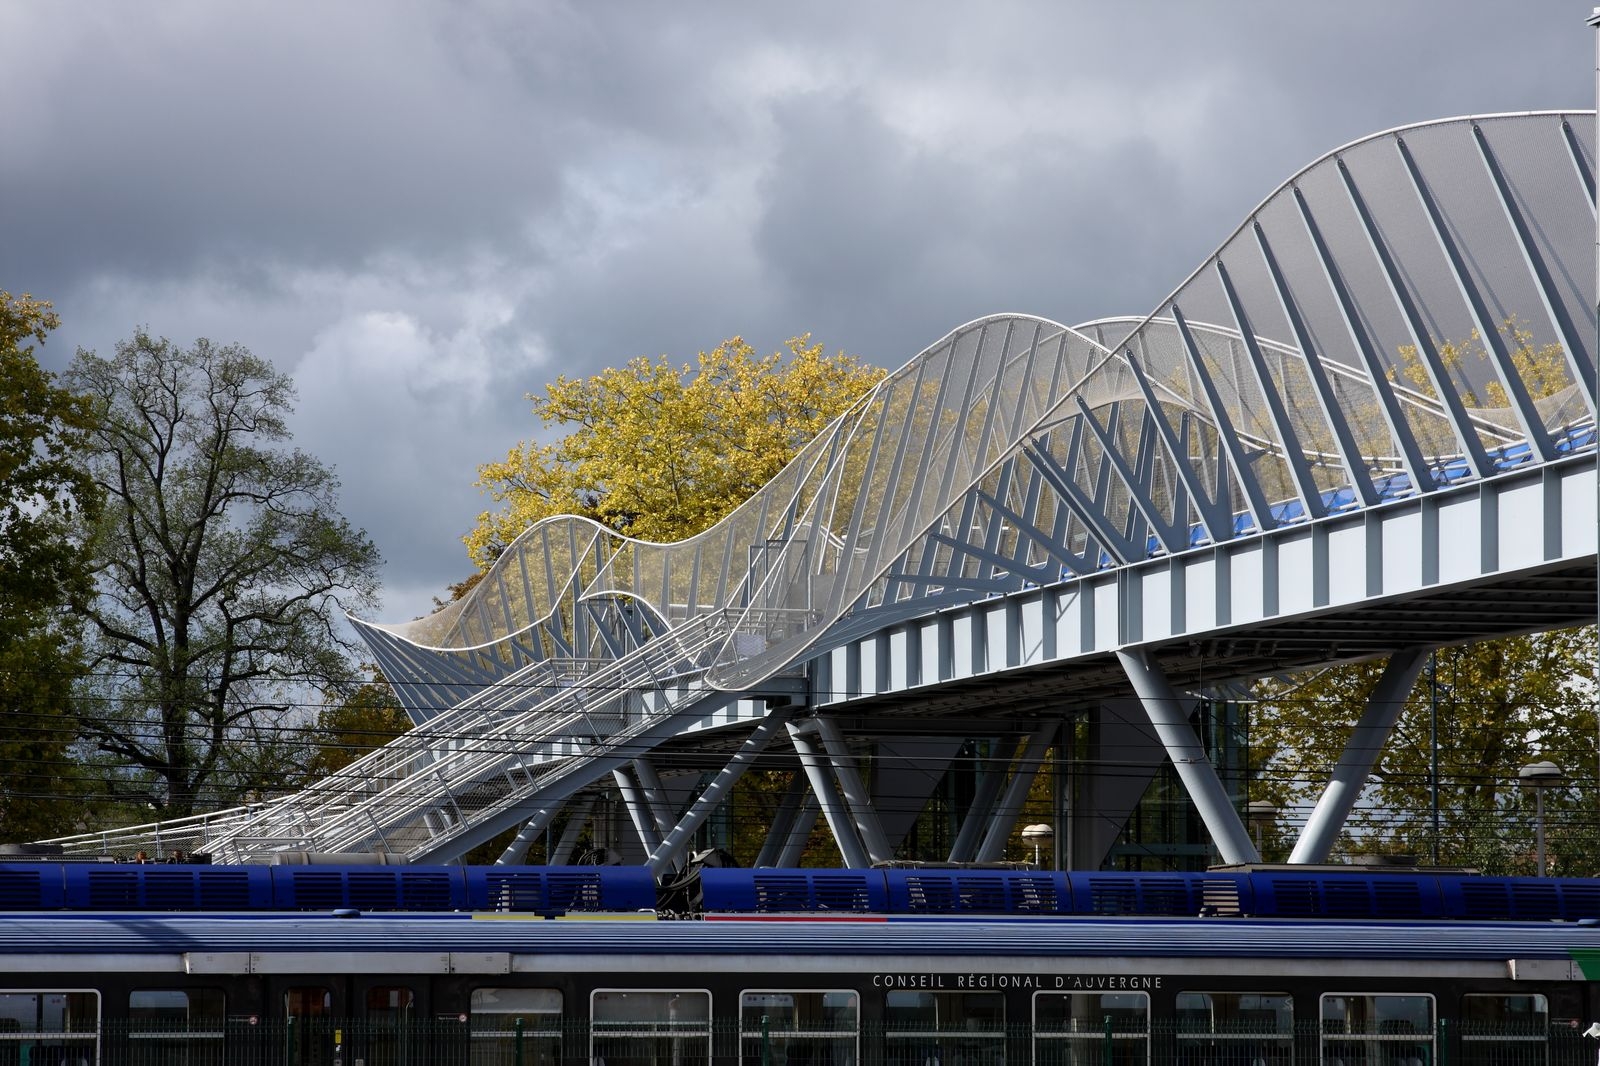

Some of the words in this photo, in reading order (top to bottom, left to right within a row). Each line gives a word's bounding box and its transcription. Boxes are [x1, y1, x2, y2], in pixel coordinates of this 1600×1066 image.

[872, 973, 945, 987] CONSEIL
[957, 973, 1042, 988] RÉGIONAL
[1055, 976, 1162, 988] D'AUVERGNE
